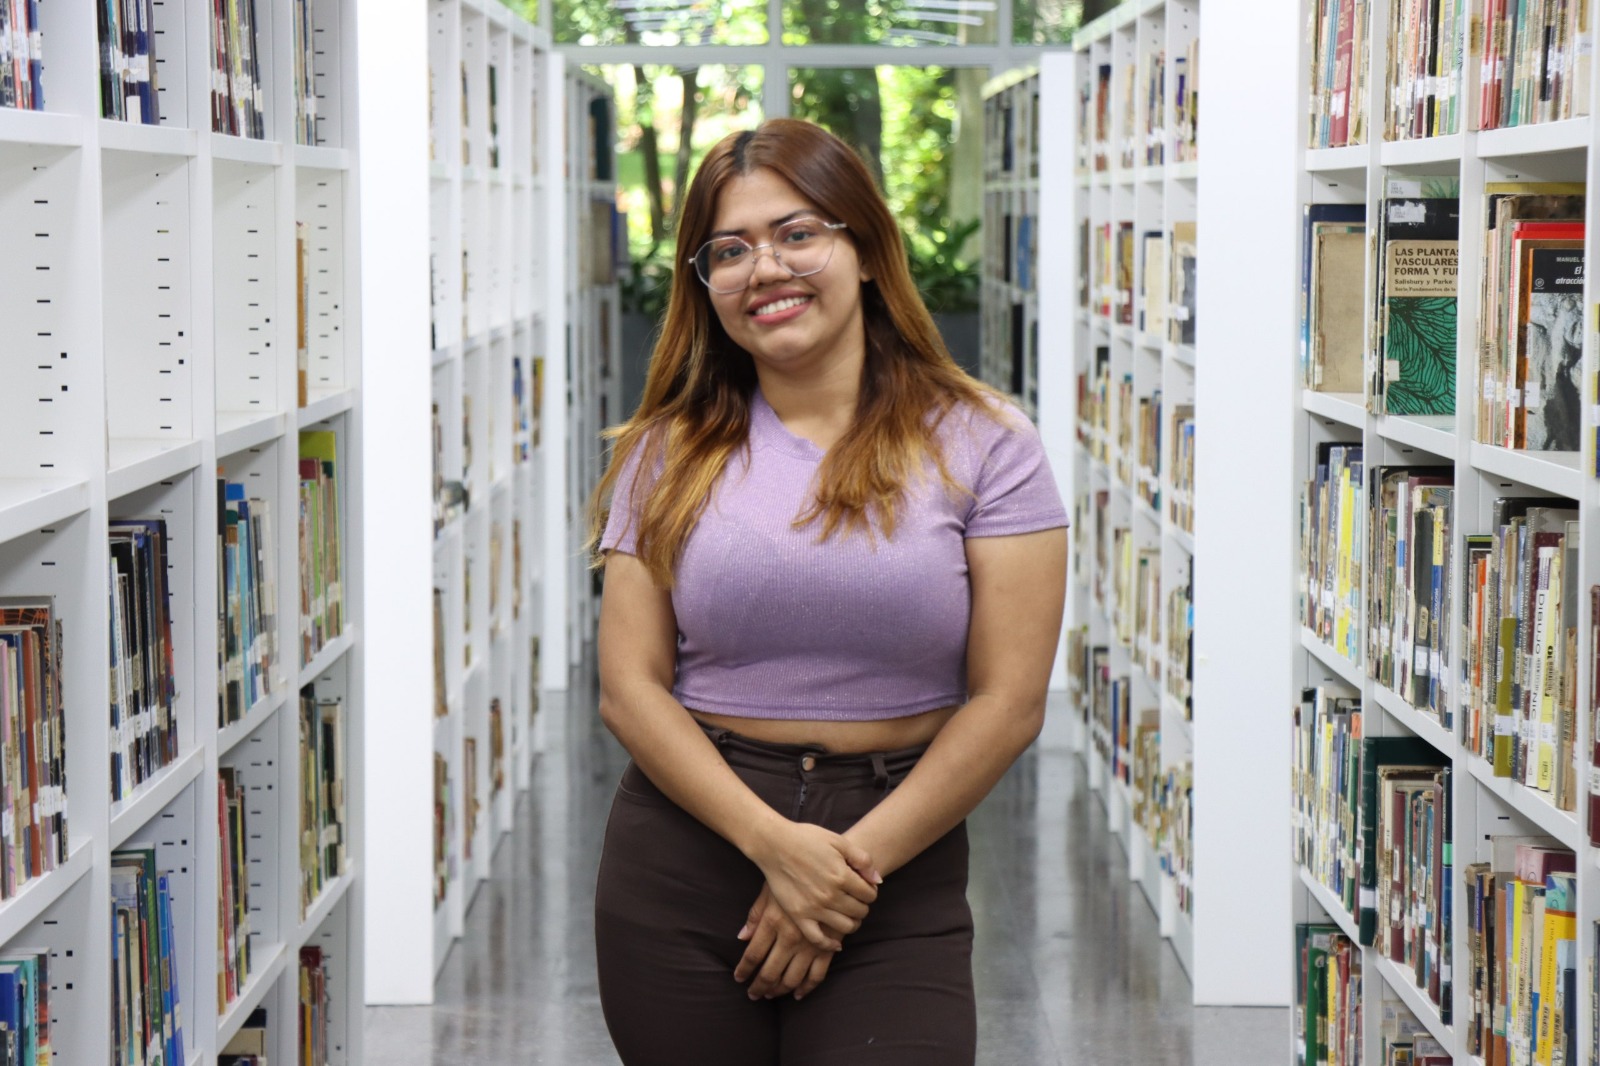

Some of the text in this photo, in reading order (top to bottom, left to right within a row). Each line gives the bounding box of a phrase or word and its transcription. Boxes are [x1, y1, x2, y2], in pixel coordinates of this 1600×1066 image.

[1395, 248, 1413, 256] LAS
[1395, 258, 1458, 266] VASCULARES
[1394, 267, 1429, 275] FORMA
[1433, 267, 1439, 275] Y
[1555, 276, 1584, 285] atracció
[1535, 593, 1545, 655] DIBUJO
